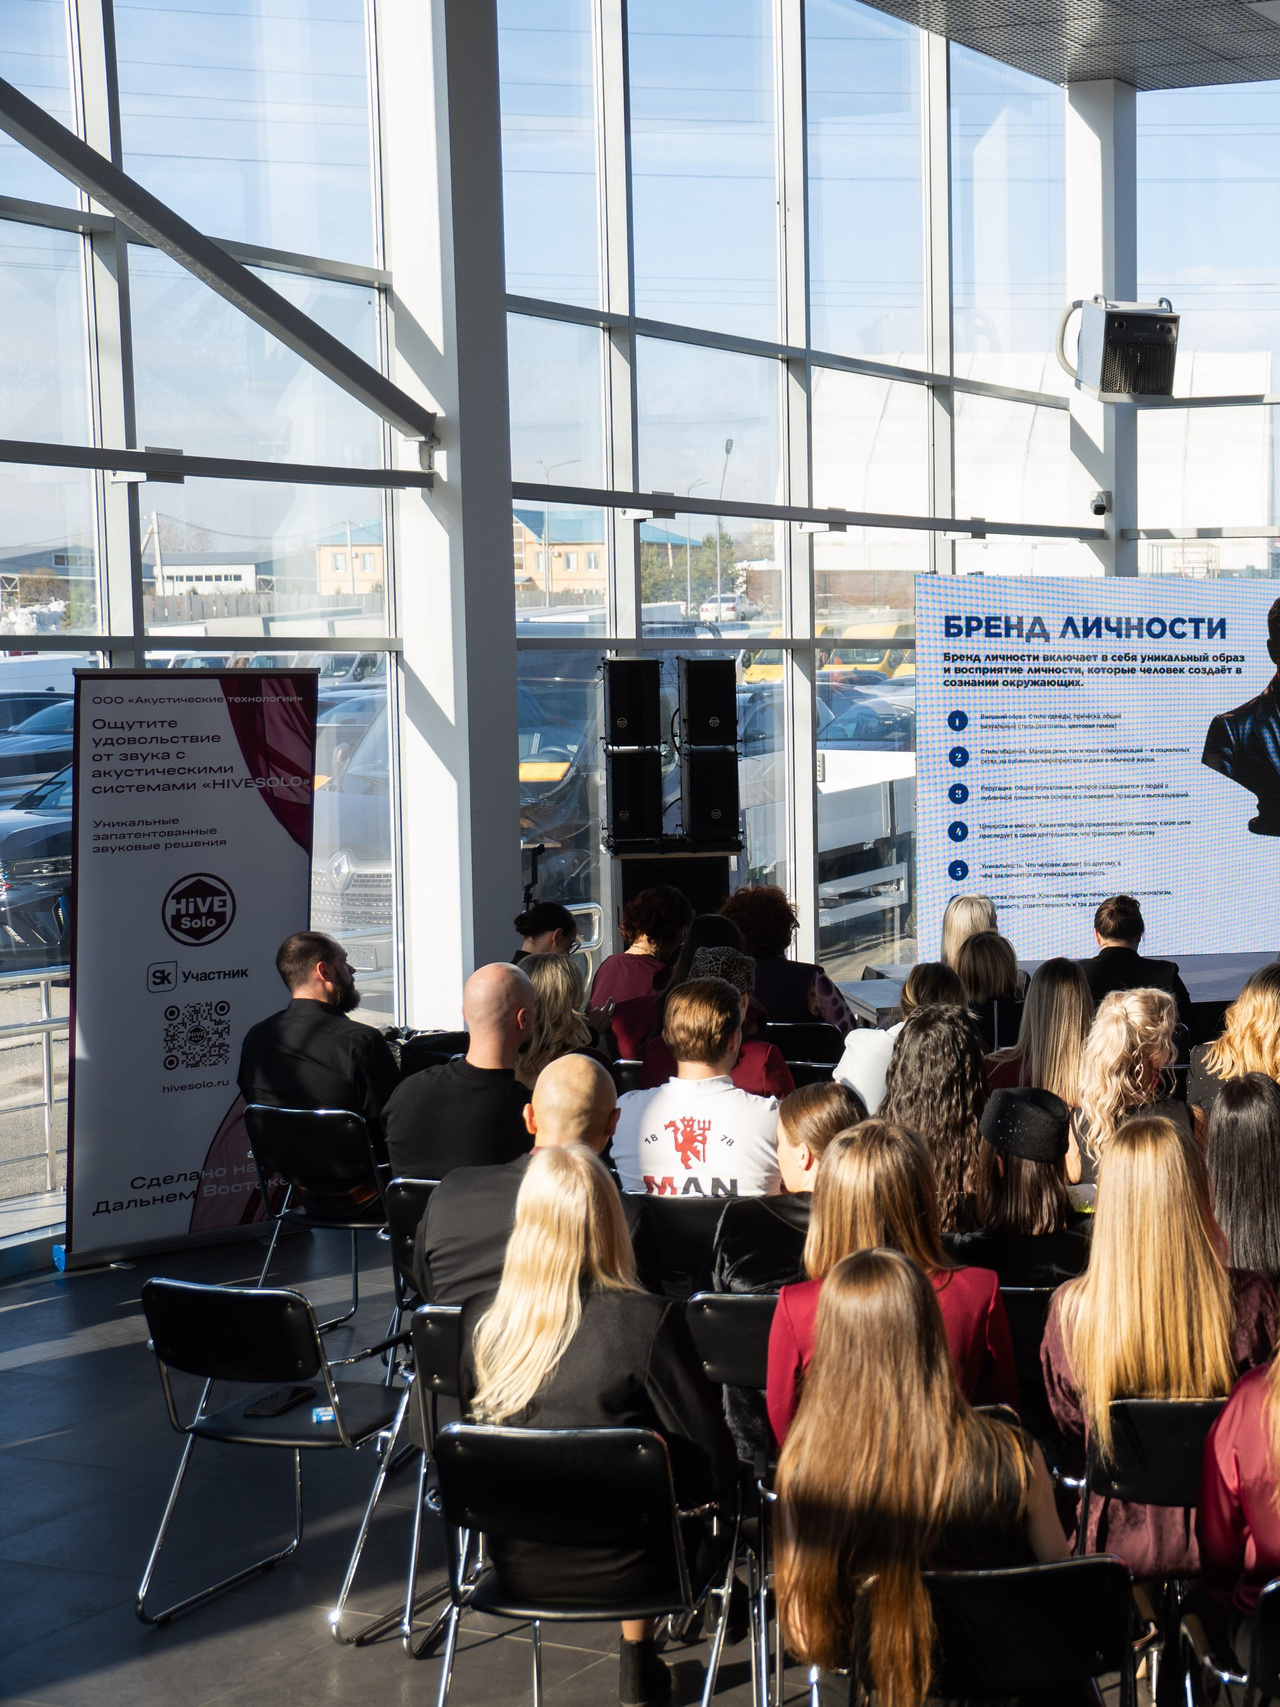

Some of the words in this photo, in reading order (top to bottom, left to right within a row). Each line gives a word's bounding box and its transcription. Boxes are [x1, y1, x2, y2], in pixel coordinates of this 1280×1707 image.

[944, 614, 1050, 643] БРЕНД
[1059, 615, 1226, 640] ЛИЧНОСТИ
[943, 652, 981, 663] Бренд
[984, 653, 1039, 663] личности
[1042, 653, 1098, 663] включает
[1102, 654, 1108, 662] в
[1111, 652, 1137, 663] себя
[1140, 652, 1209, 665] уникальный
[1212, 652, 1245, 665] образ
[943, 666, 951, 674] и
[954, 665, 1023, 677] восприятие
[1026, 665, 1084, 676] личности,
[1087, 665, 1136, 677] которые
[1139, 665, 1185, 675] человек
[1188, 664, 1232, 676] создаёт
[1236, 665, 1242, 674] в
[943, 678, 999, 687] сознании
[1002, 678, 1084, 690] окружающих.
[92, 696, 124, 705] ООО
[128, 695, 224, 705] «Акустические
[92, 718, 178, 731] Ощутите
[92, 734, 221, 748] удовольствие
[92, 753, 114, 761] от
[119, 752, 170, 763] звука
[176, 751, 185, 759] с
[955, 753, 962, 761] 2
[92, 765, 234, 780] акустическими
[92, 781, 197, 794] системами
[202, 776, 310, 789] «HIVESOLO»
[955, 790, 962, 798] 3
[93, 817, 179, 829] Уникальные
[92, 827, 217, 841] запатентованные
[92, 841, 160, 854] звуковые
[164, 839, 227, 851] решения
[956, 867, 962, 876] 5
[181, 916, 216, 929] Solo
[152, 969, 172, 985] Sk
[181, 968, 249, 983] Участник
[162, 1080, 229, 1093] hivesolo.ru
[644, 1133, 659, 1145] 18
[720, 1134, 735, 1147] 78
[130, 1168, 227, 1189] Сделано
[233, 1162, 258, 1174] на
[643, 1175, 738, 1196] MAN
[92, 1191, 196, 1216] Дальнем
